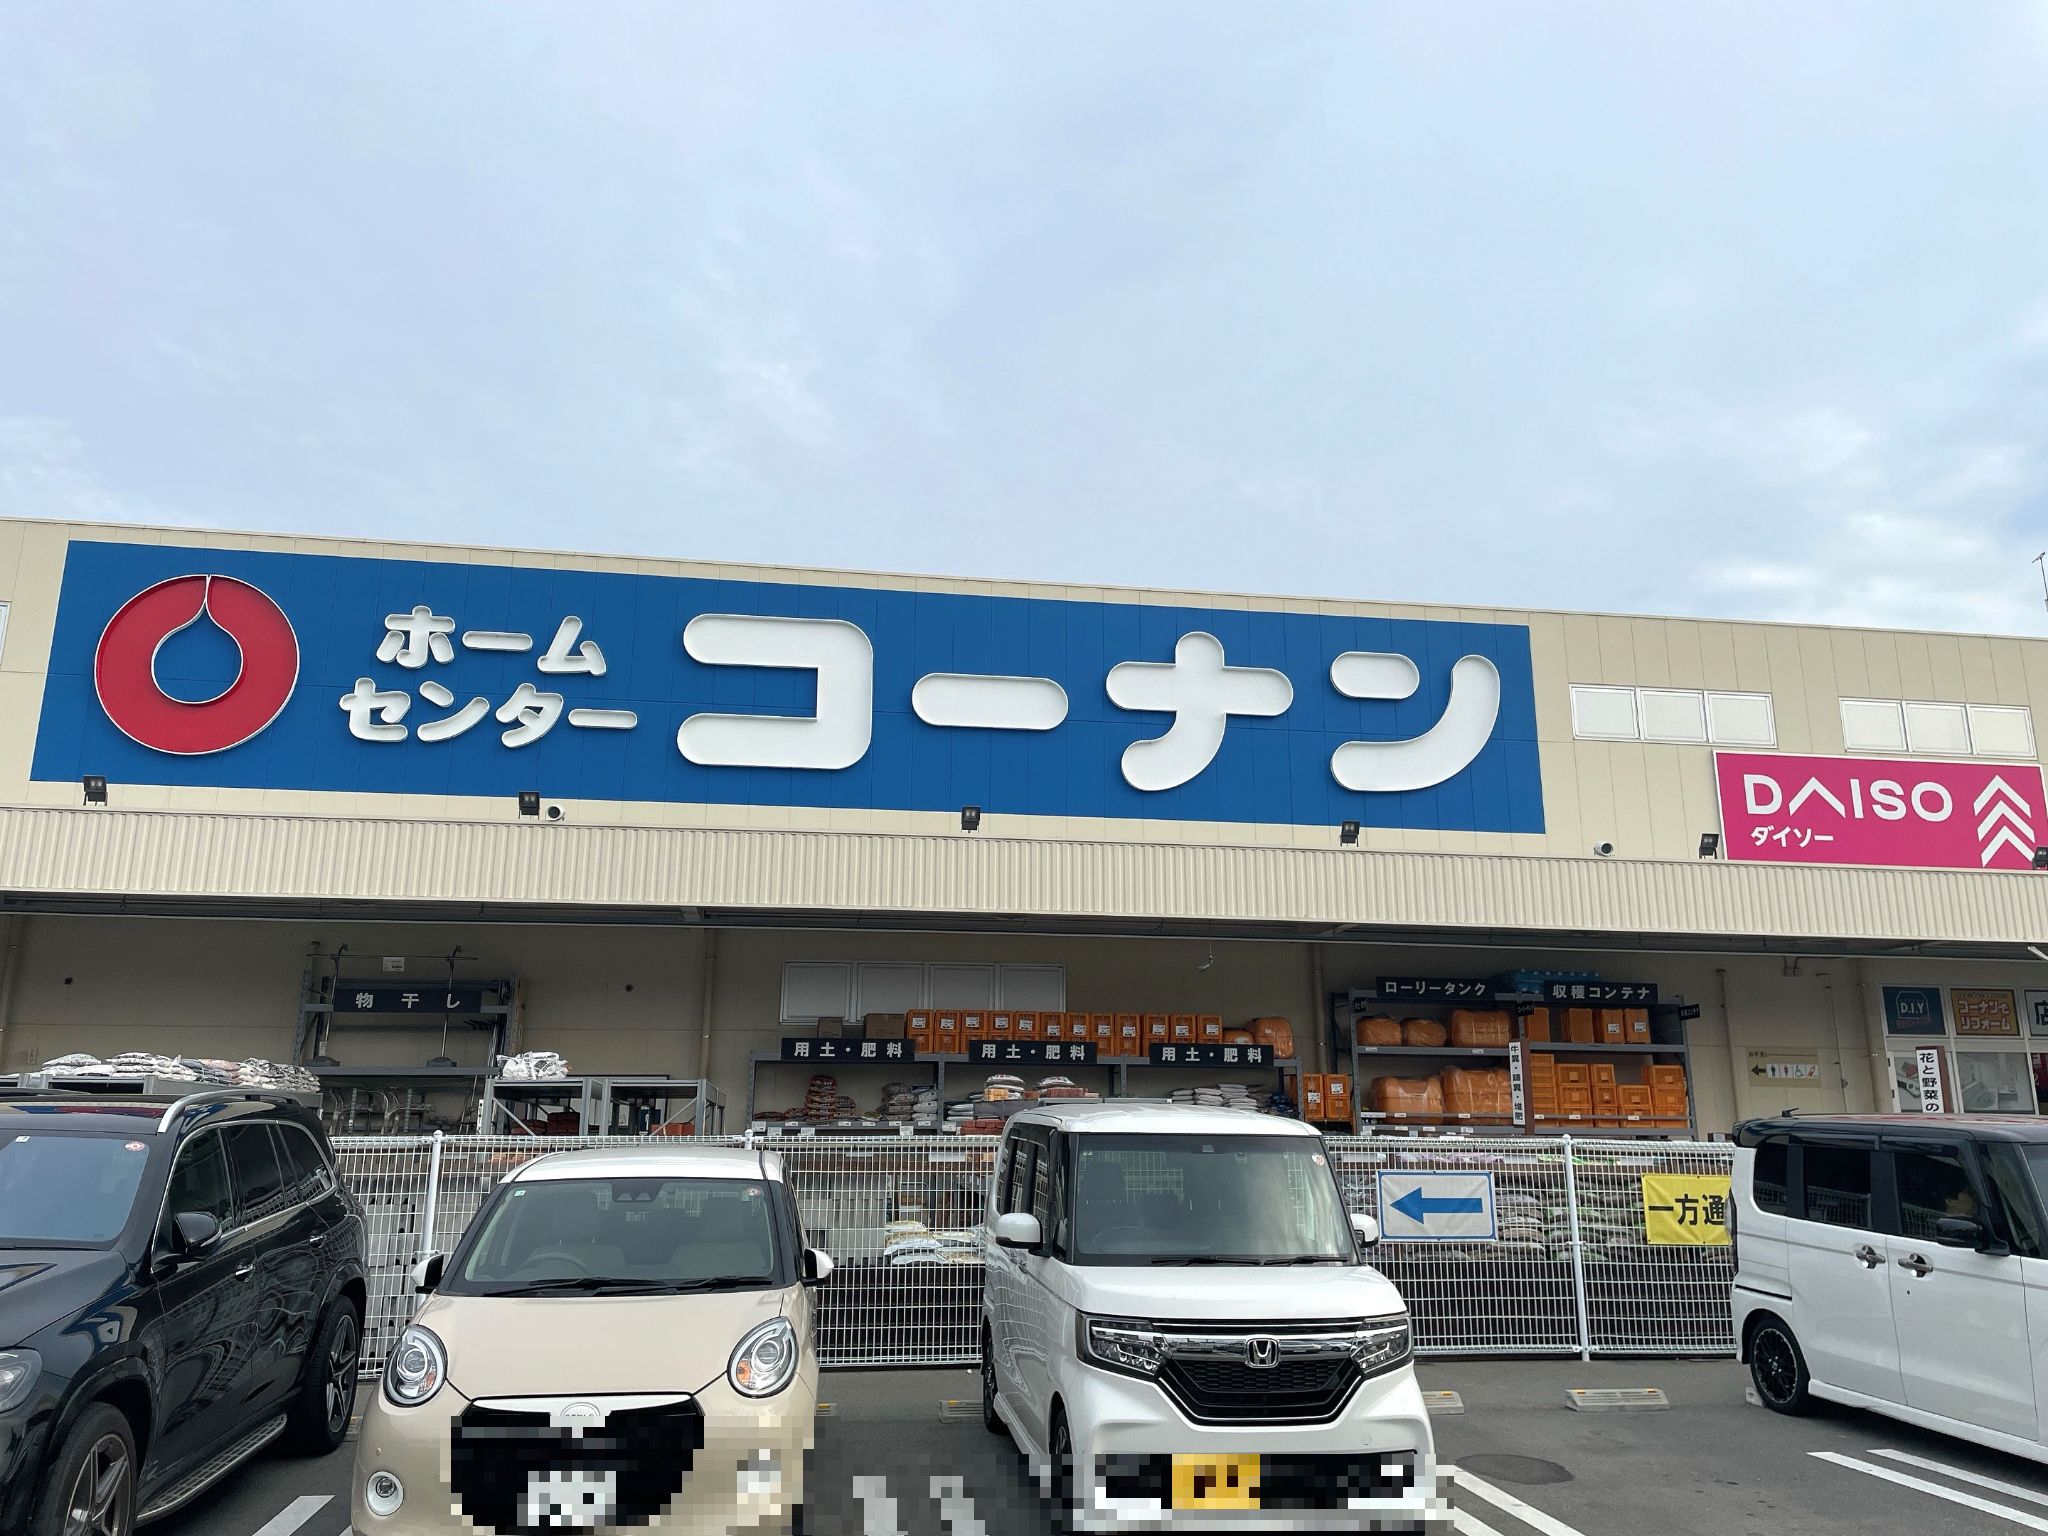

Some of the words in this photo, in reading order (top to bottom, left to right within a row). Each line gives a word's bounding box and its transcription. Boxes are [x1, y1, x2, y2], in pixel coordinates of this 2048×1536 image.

[376, 605, 607, 676] ホーム
[339, 677, 638, 748] センター
[677, 613, 1501, 793] コーナン
[1743, 773, 1953, 822] DAISO
[1751, 825, 1834, 848] ダイソー
[1385, 980, 1486, 996] ローリータンク
[1553, 984, 1650, 1000] 収穫コンテナ
[355, 992, 461, 1009] 物干し
[794, 1042, 903, 1058] 用土・肥料
[981, 1043, 1086, 1060] 用土・肥料
[1161, 1046, 1263, 1063] 用土・肥料
[1919, 1053, 1940, 1112] 花と野菜の
[1648, 1193, 1725, 1226] 一方通
